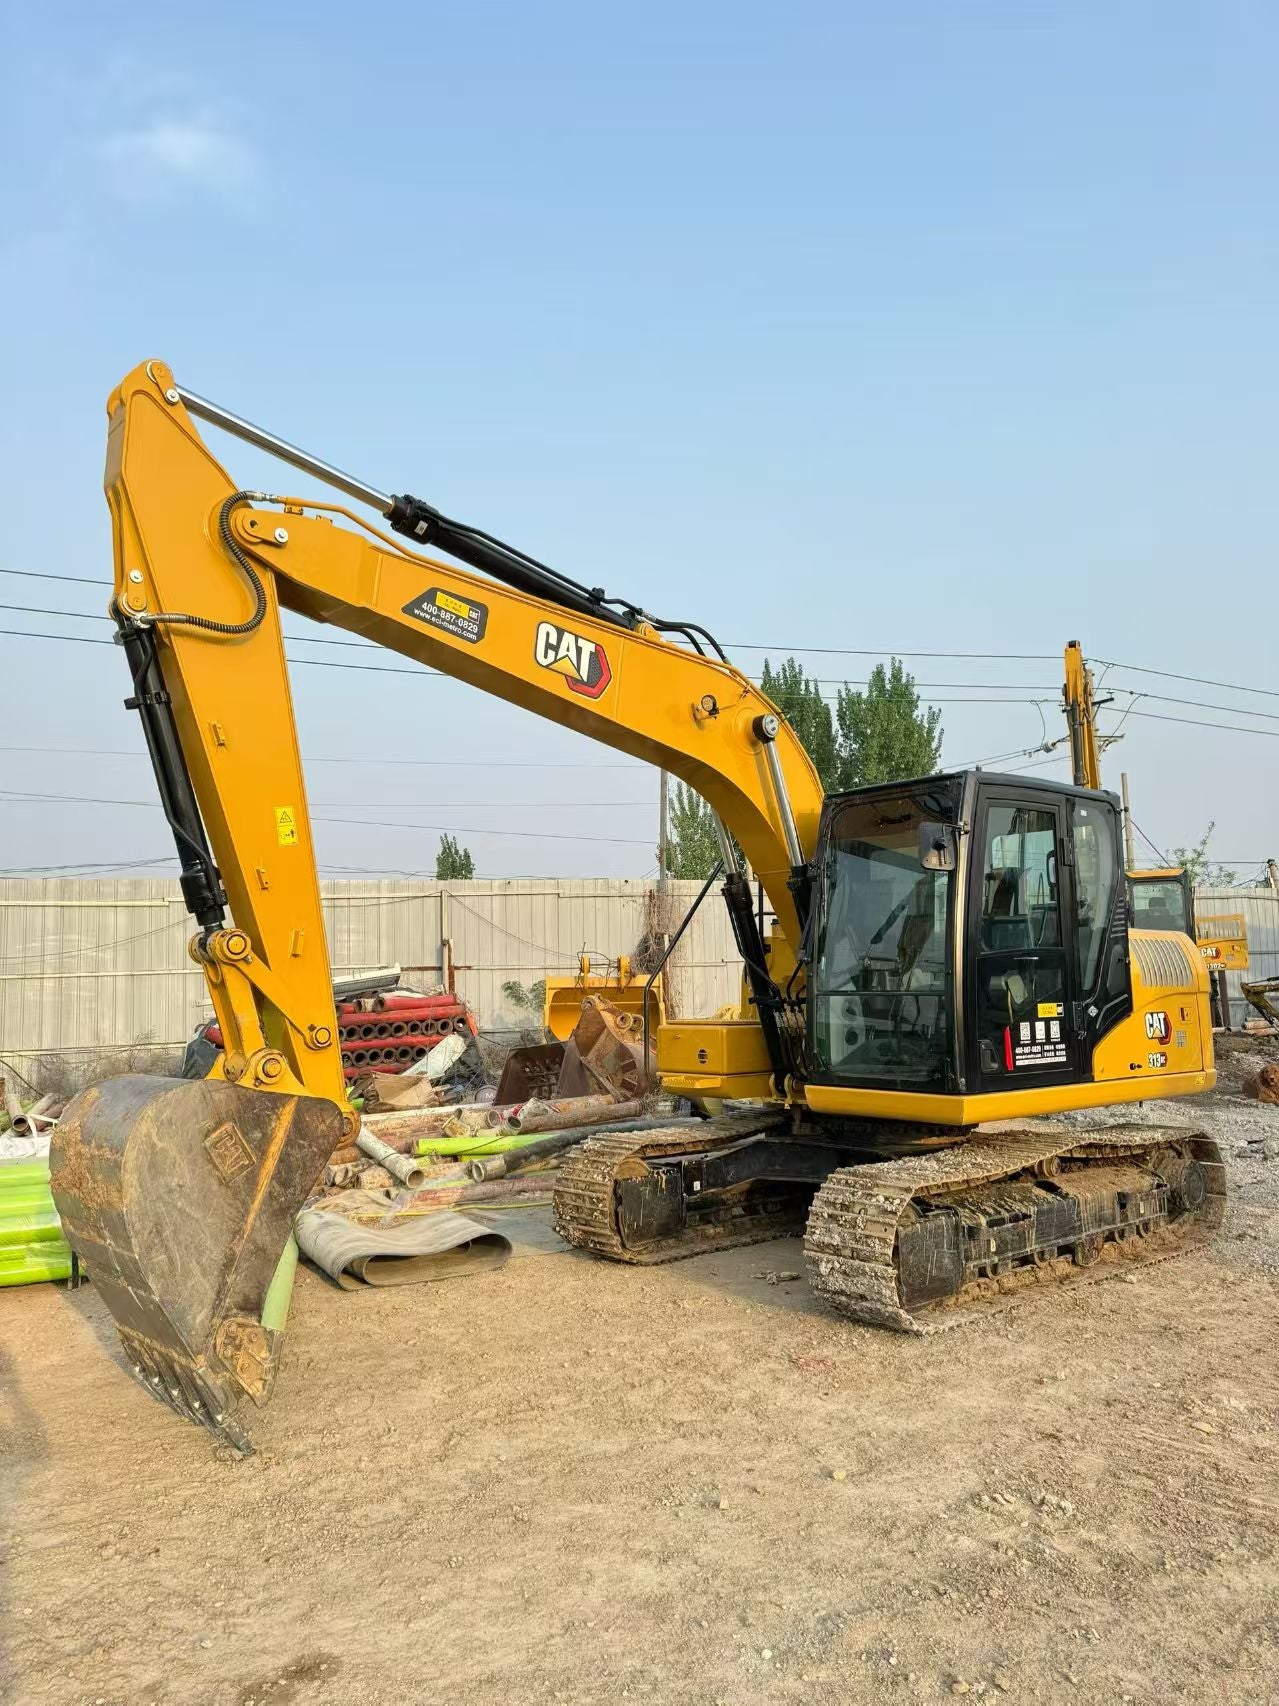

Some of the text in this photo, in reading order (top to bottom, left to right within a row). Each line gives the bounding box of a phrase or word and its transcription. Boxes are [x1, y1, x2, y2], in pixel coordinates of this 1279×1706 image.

[414, 608, 477, 640] www.eci-metro.com
[422, 602, 478, 633] 400-887-0829
[536, 622, 596, 682] CAT
[1201, 947, 1217, 959] CAT
[1144, 1012, 1165, 1039] CAT
[1148, 1052, 1160, 1068] 313
[212, 1130, 250, 1174] CAT
